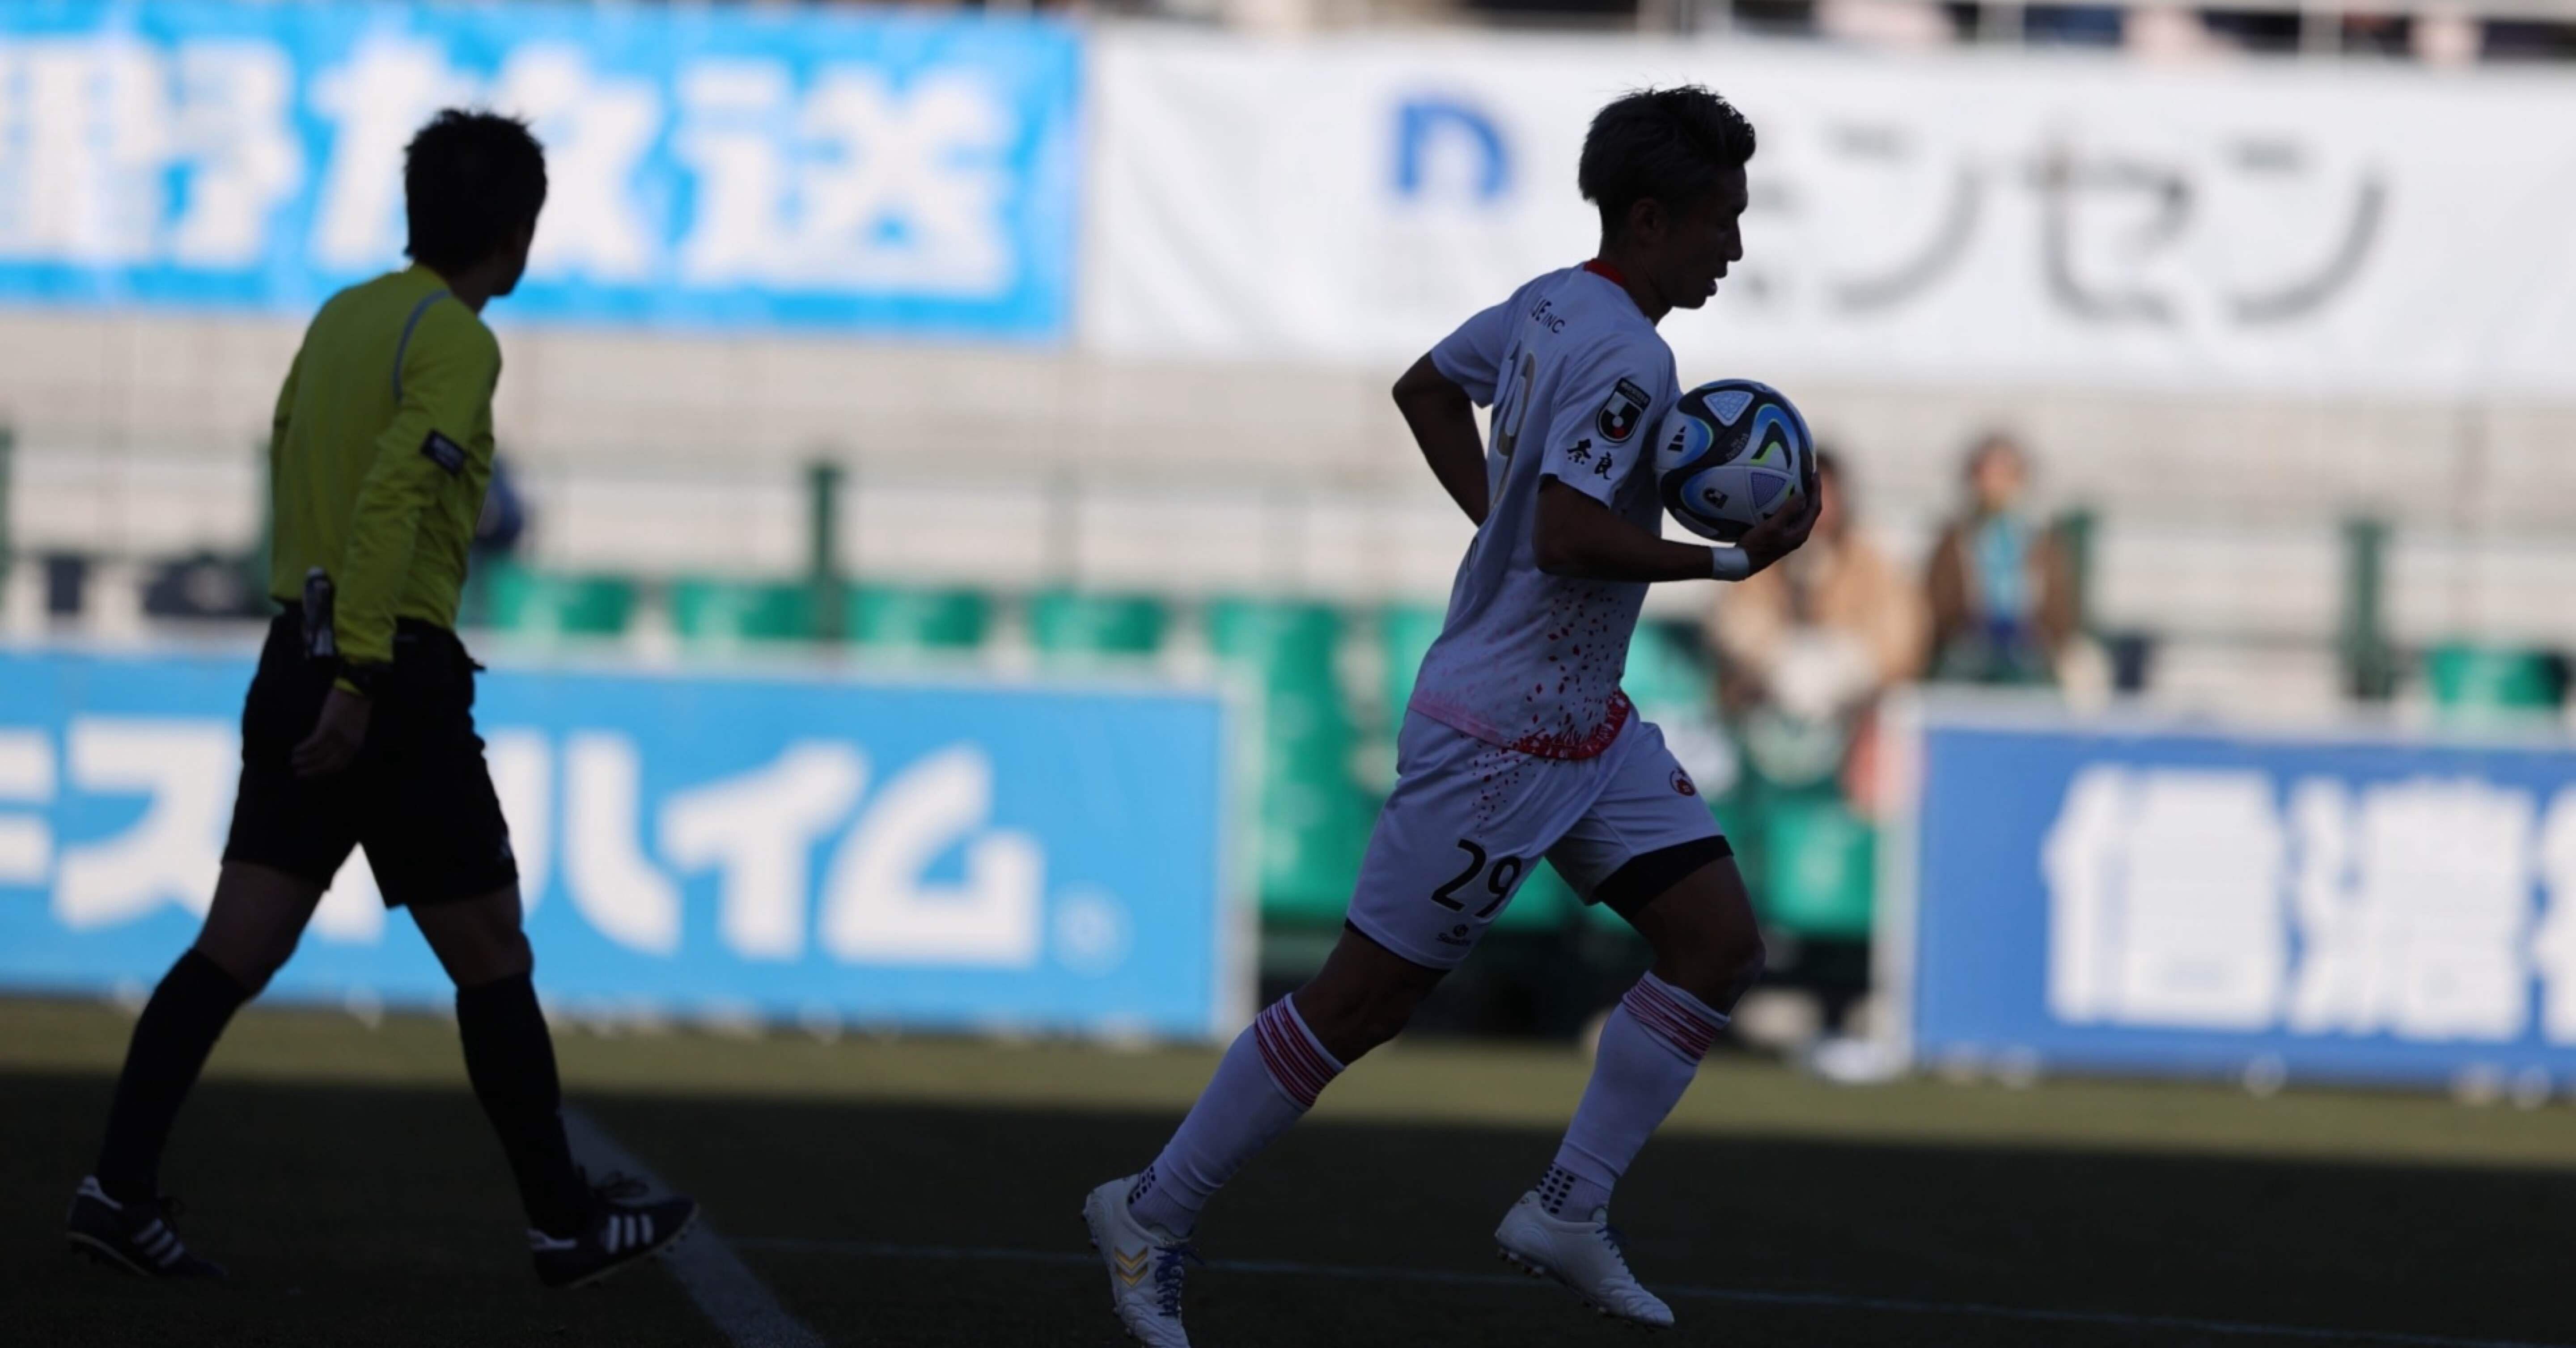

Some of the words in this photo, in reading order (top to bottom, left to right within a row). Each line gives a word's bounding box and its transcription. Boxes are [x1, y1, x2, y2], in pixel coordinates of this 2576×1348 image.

[1737, 118, 2393, 331] ンセン
[1567, 439, 1613, 480] 奈良
[1431, 838, 1521, 918] 29
